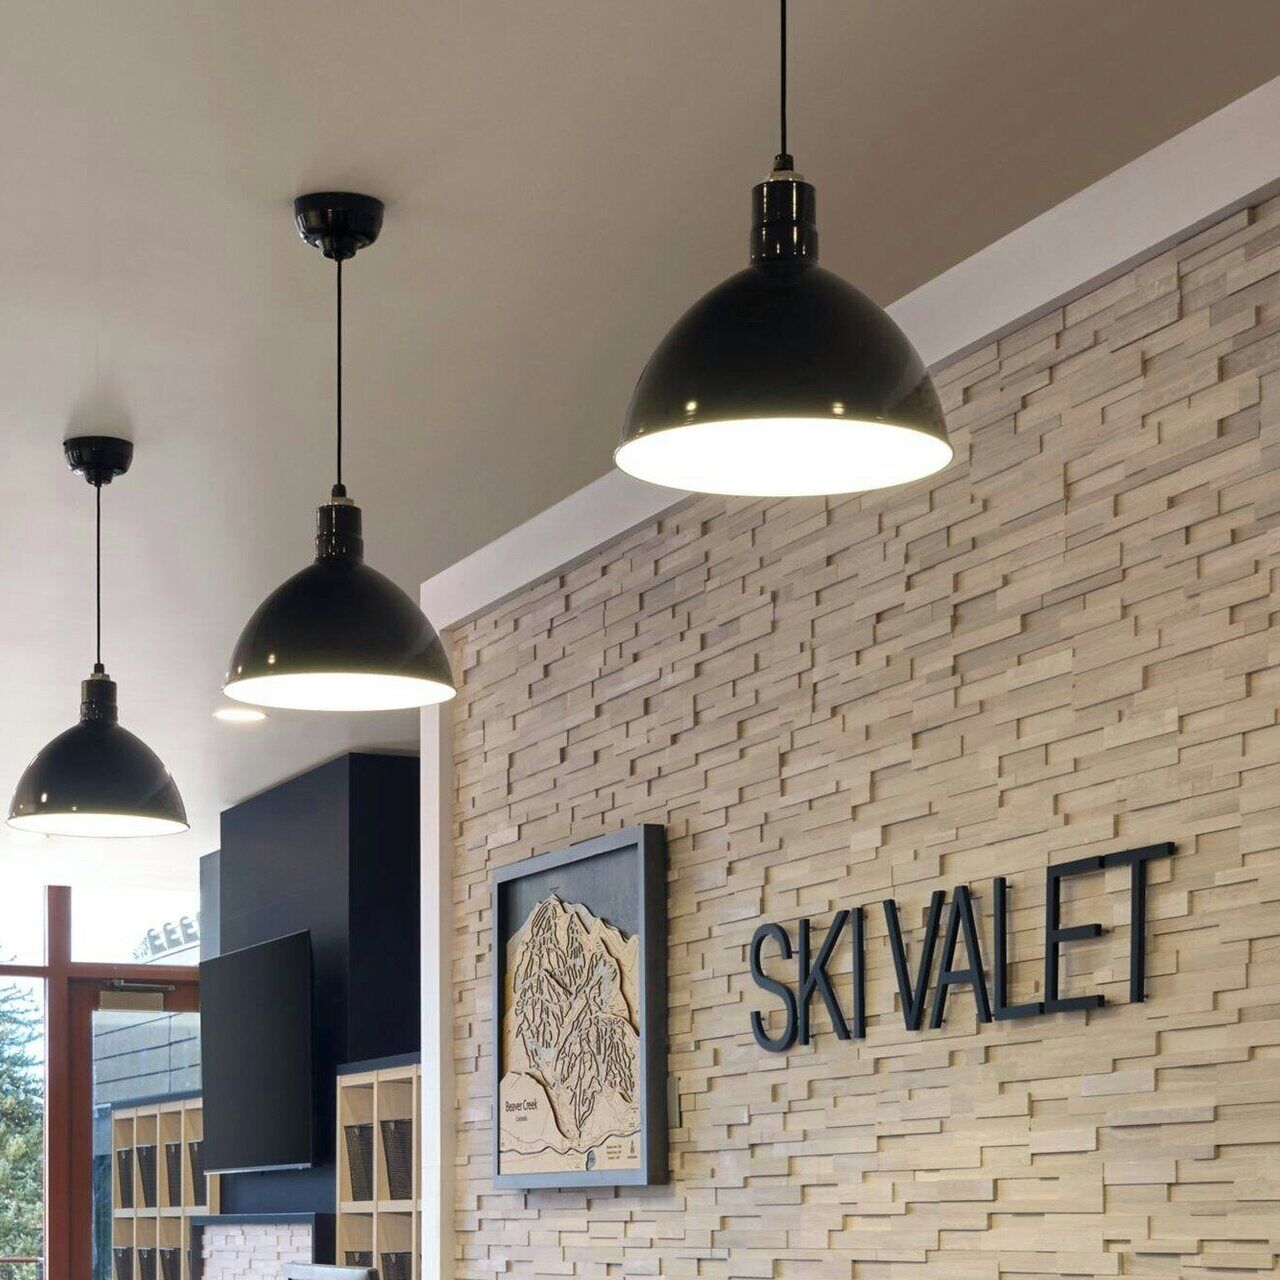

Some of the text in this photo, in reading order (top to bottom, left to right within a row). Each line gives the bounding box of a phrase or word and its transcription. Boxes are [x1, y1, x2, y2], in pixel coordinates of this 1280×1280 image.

[750, 842, 1177, 1053] SKI VALET
[505, 1098, 538, 1112] Beaver Creek
